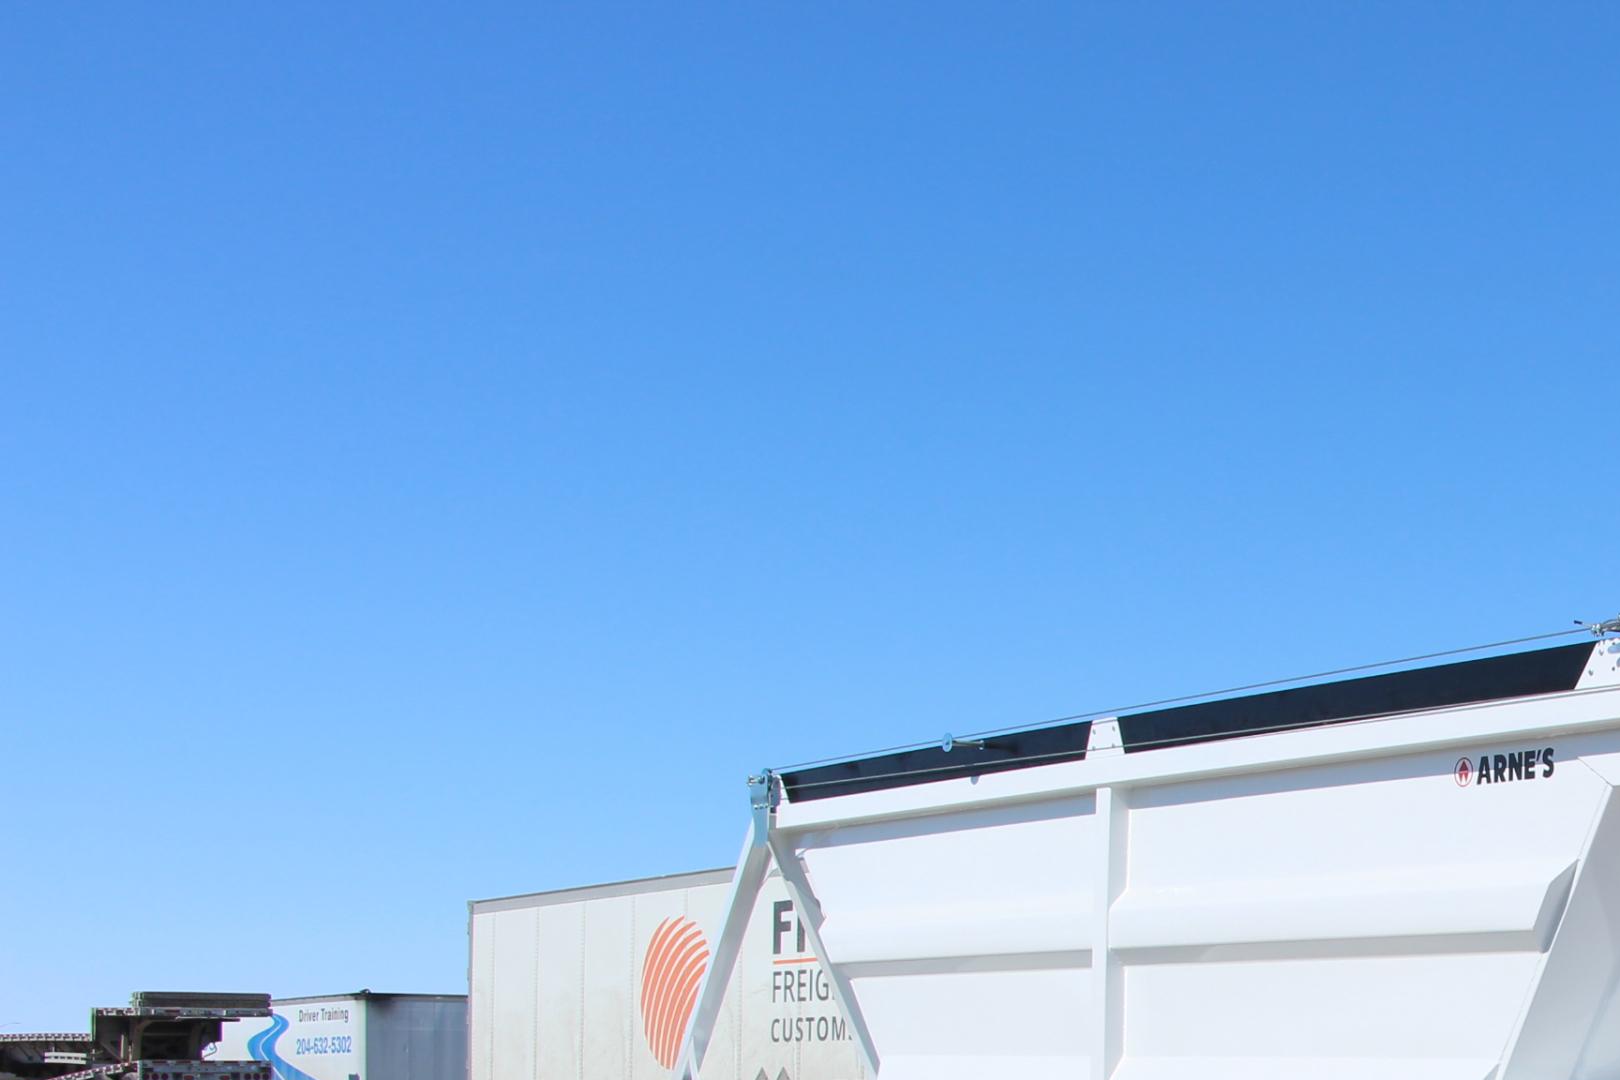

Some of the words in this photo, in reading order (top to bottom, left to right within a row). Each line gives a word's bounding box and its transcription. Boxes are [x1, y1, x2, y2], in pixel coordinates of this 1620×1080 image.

[1476, 747, 1554, 785] ARNE'S
[772, 970, 834, 1003] FREIG
[299, 1009, 319, 1022] Driver
[321, 1007, 349, 1023] Training
[771, 1016, 852, 1042] CUSTOM
[296, 1035, 352, 1055] 204-632-5302
